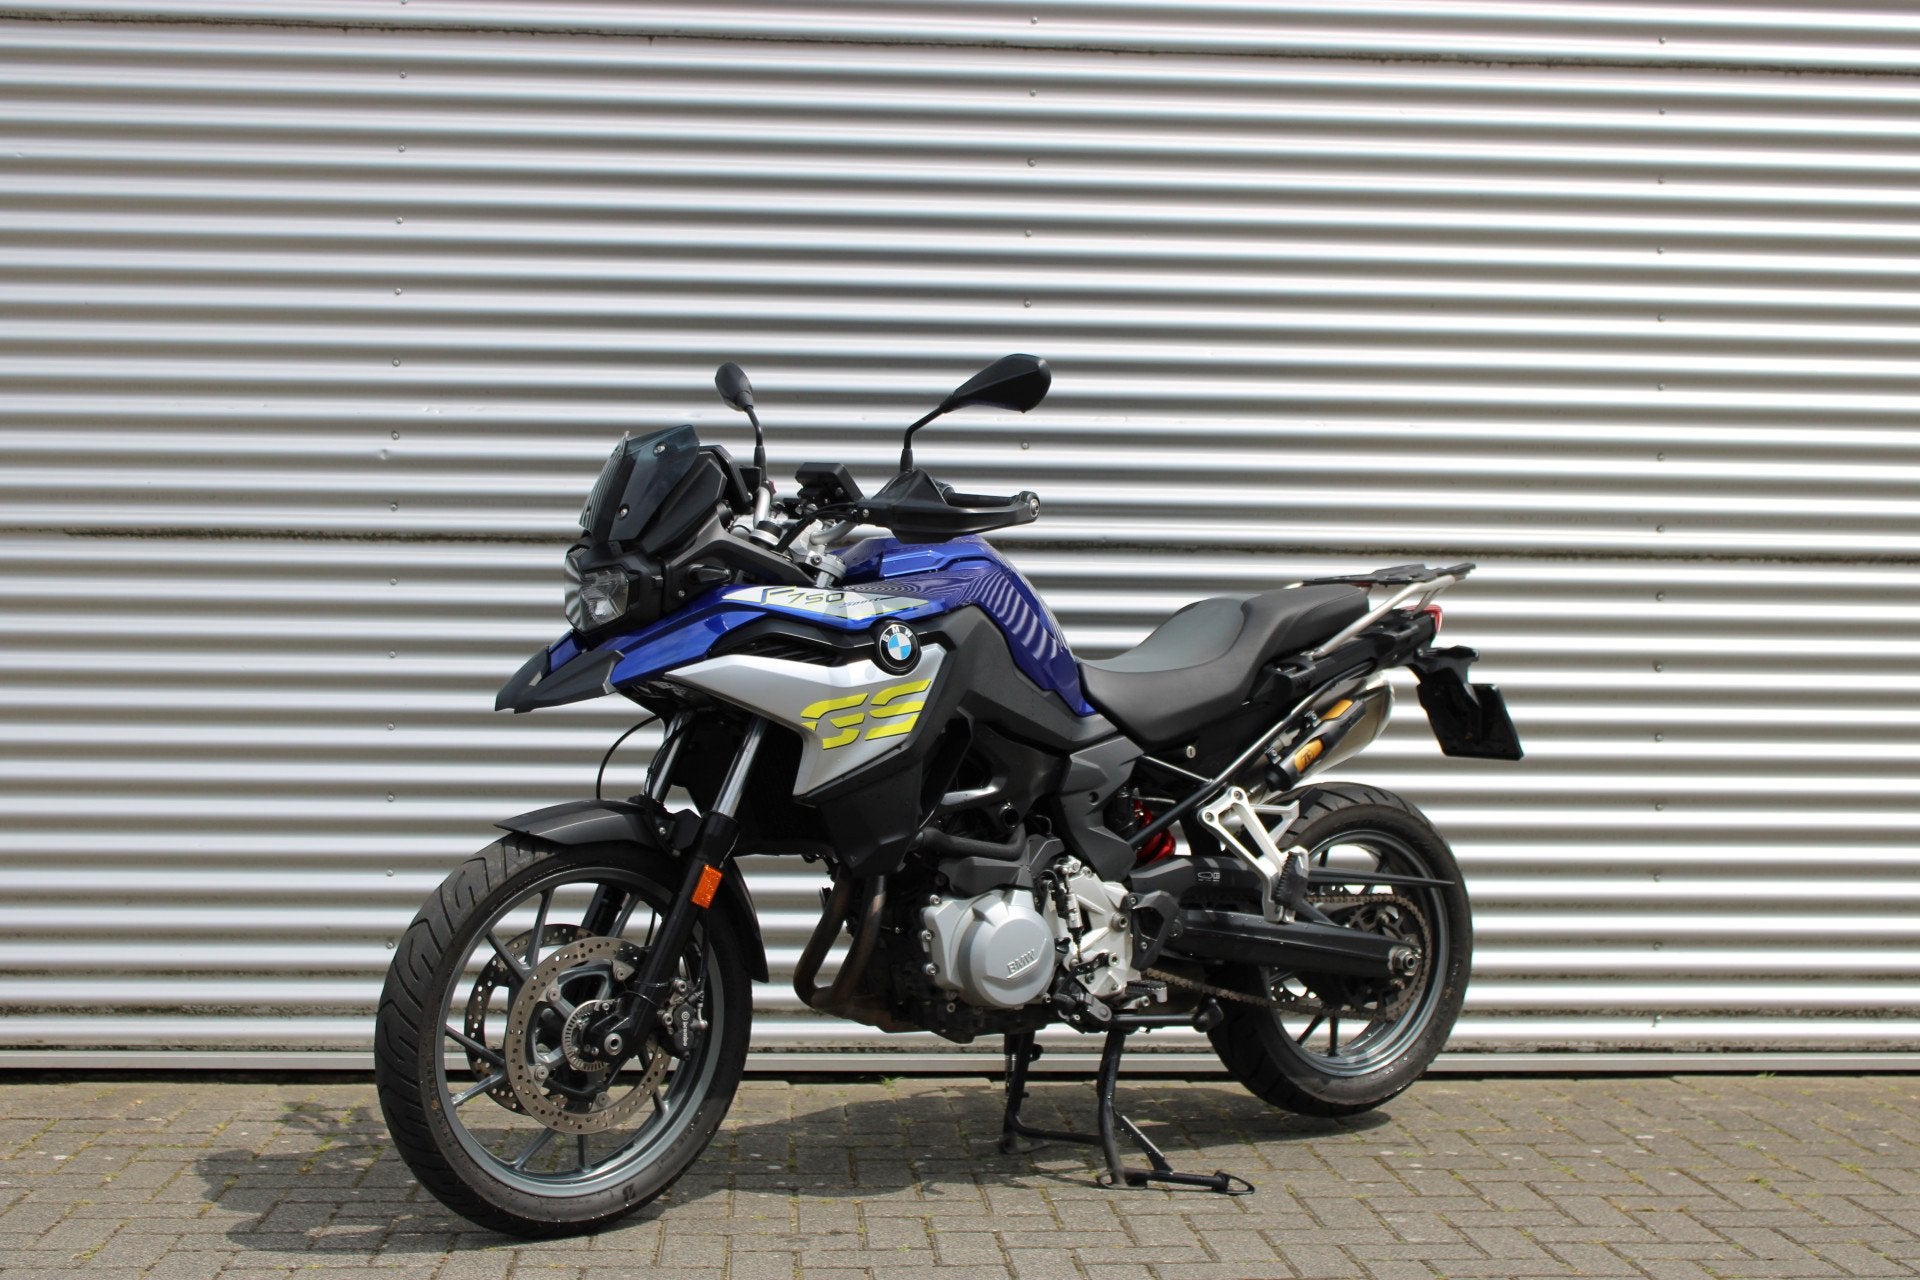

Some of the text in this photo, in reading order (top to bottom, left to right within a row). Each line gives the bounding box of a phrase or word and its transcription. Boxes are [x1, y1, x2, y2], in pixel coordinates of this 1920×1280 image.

[882, 625, 914, 643] BMW
[800, 678, 931, 750] GS
[1007, 948, 1036, 974] BMW
